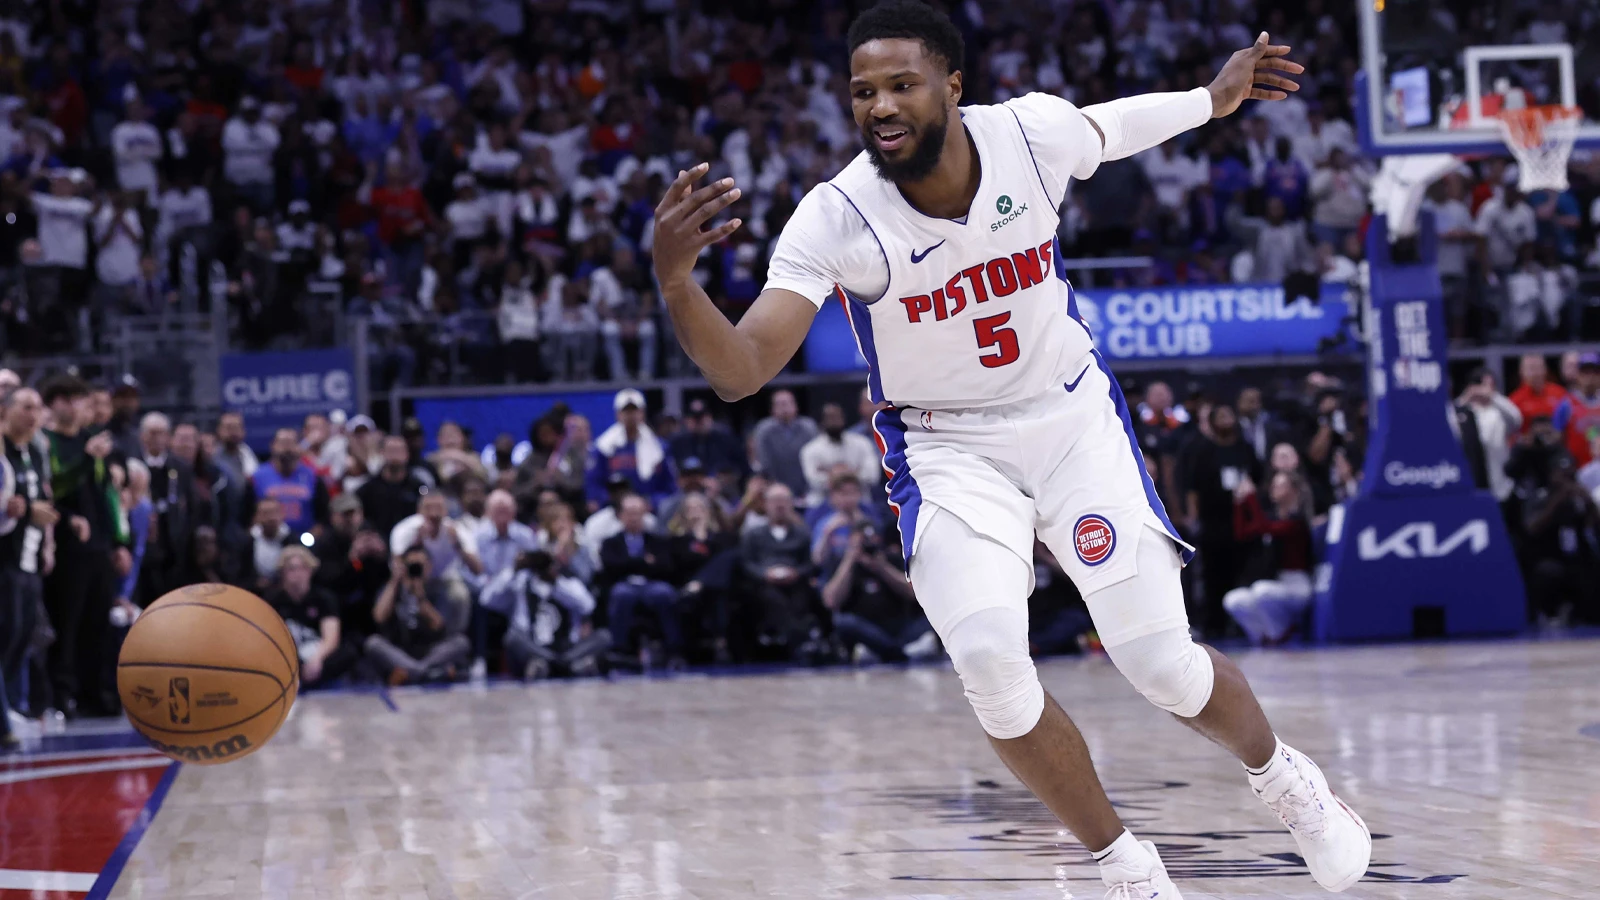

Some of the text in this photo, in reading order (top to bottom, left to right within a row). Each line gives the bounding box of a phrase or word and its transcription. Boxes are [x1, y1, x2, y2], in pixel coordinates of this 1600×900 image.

[990, 202, 1029, 232] StockX
[899, 239, 1053, 323] PISTONS
[972, 310, 1020, 368] 5
[1106, 323, 1212, 358] CLUB
[1384, 460, 1460, 488] Google
[1079, 528, 1105, 543] DETROIT
[1081, 537, 1107, 552] PISTONS
